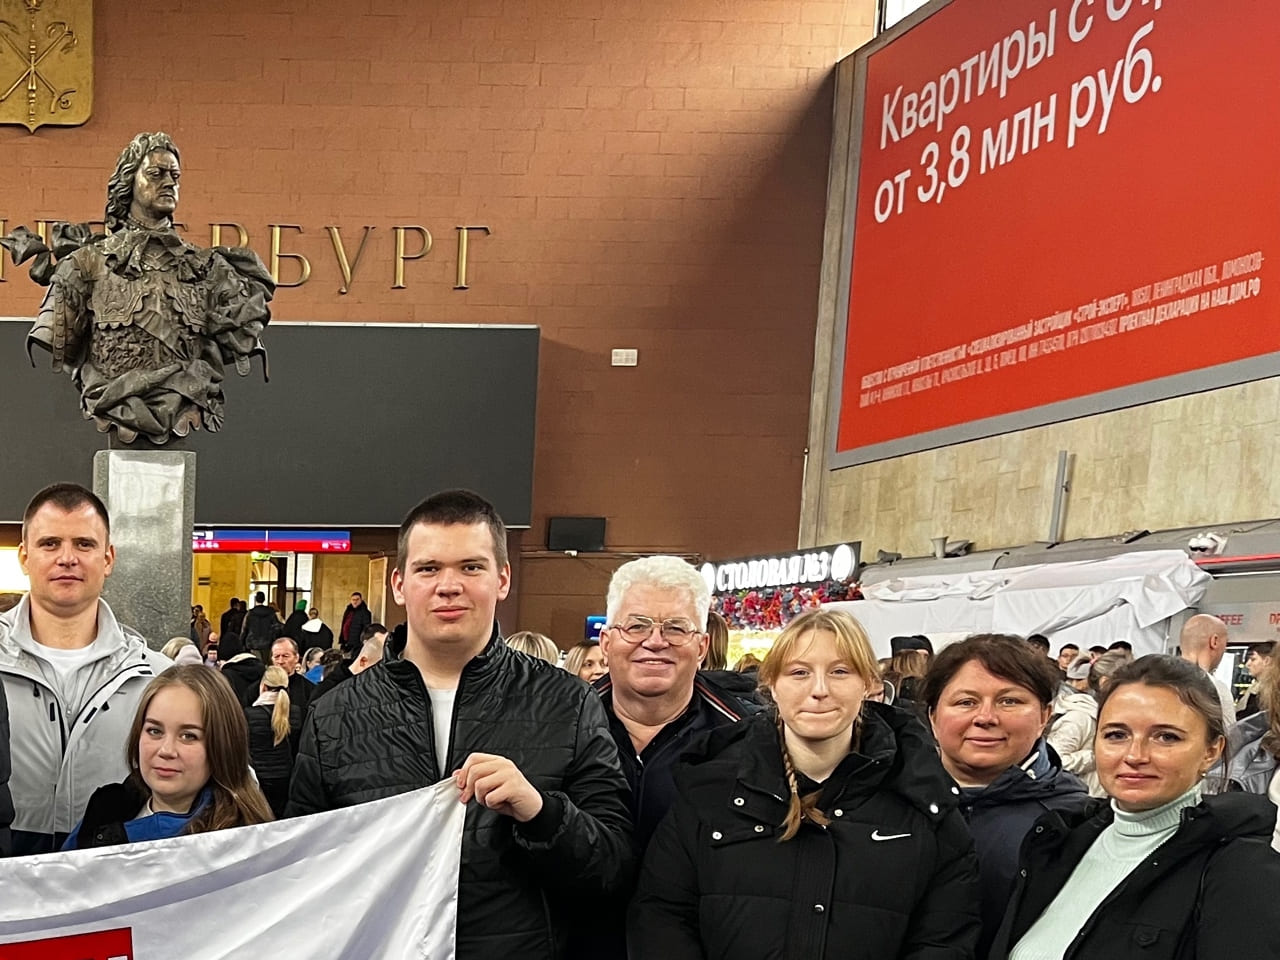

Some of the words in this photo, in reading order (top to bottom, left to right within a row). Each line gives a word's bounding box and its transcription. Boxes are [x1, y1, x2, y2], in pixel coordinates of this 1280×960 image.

[874, 168, 912, 223] от
[917, 125, 971, 204] 3,8
[980, 93, 1058, 175] млн
[1067, 20, 1162, 148] руб.
[879, 8, 1057, 150] Квартиры
[1067, 0, 1094, 42] с
[717, 555, 802, 592] СТОЛОВАЯ
[800, 551, 831, 584] №3
